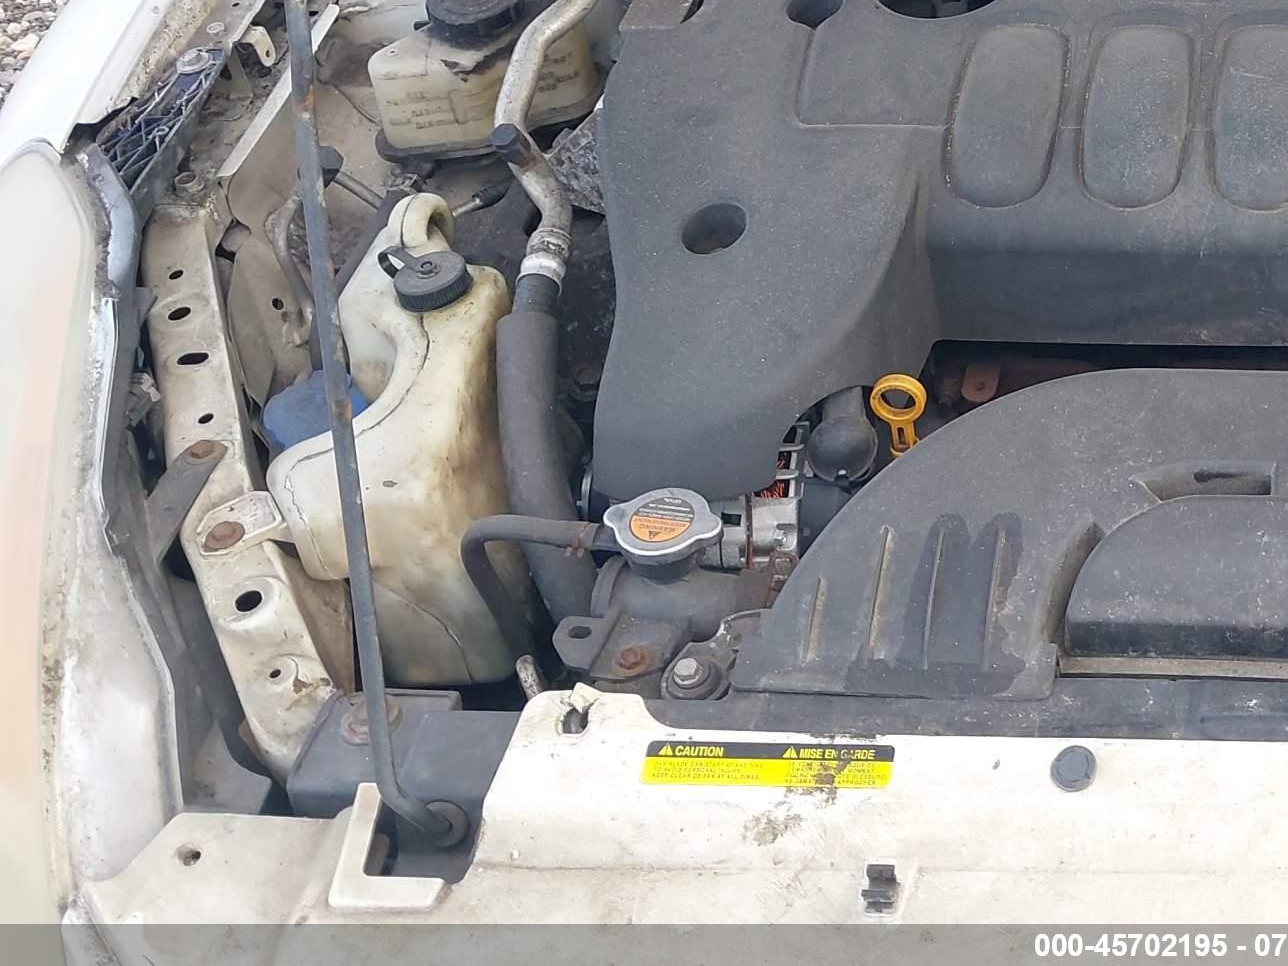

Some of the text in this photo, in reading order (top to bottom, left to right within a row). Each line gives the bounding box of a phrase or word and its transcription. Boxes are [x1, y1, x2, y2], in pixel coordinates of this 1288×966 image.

[675, 745, 724, 757] CAUTION
[799, 748, 823, 759] MISE
[824, 749, 838, 759] EN
